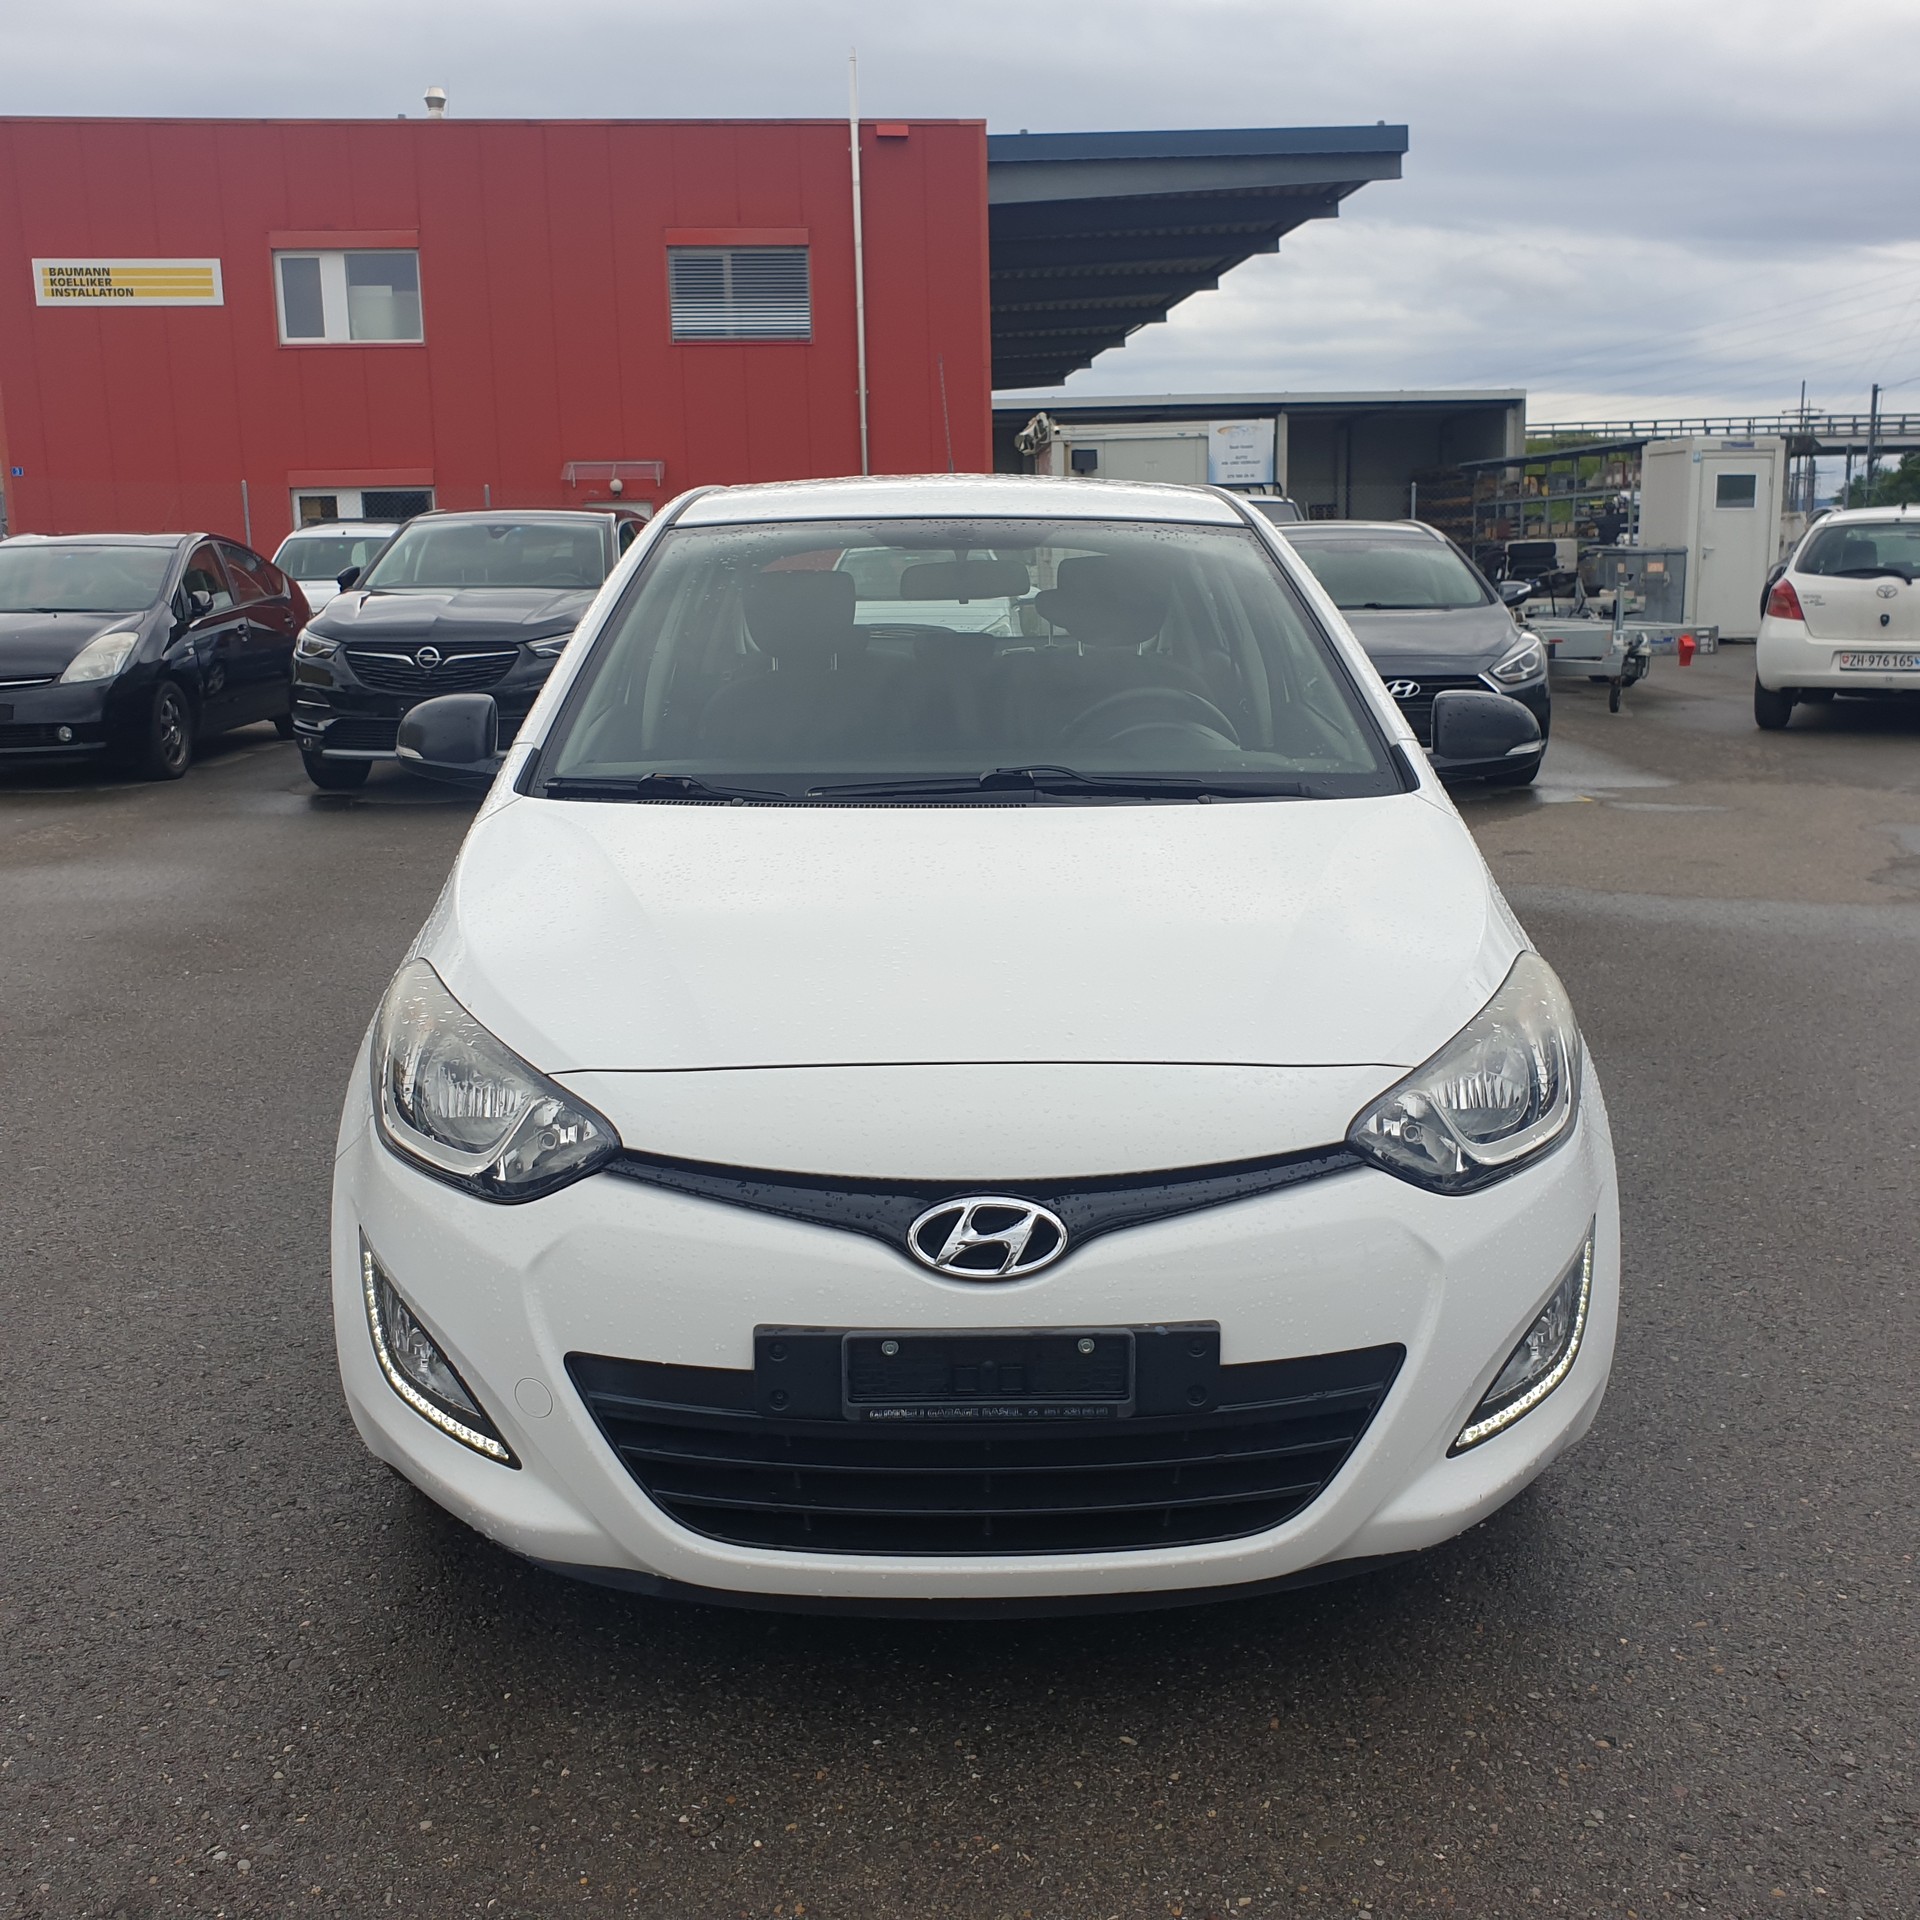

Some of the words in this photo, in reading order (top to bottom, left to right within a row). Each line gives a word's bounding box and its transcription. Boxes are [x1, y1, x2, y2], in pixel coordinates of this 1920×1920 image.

[48, 267, 111, 277] BAUMANN
[50, 278, 113, 287] KOELLIKER
[51, 287, 135, 297] INSTALLATION
